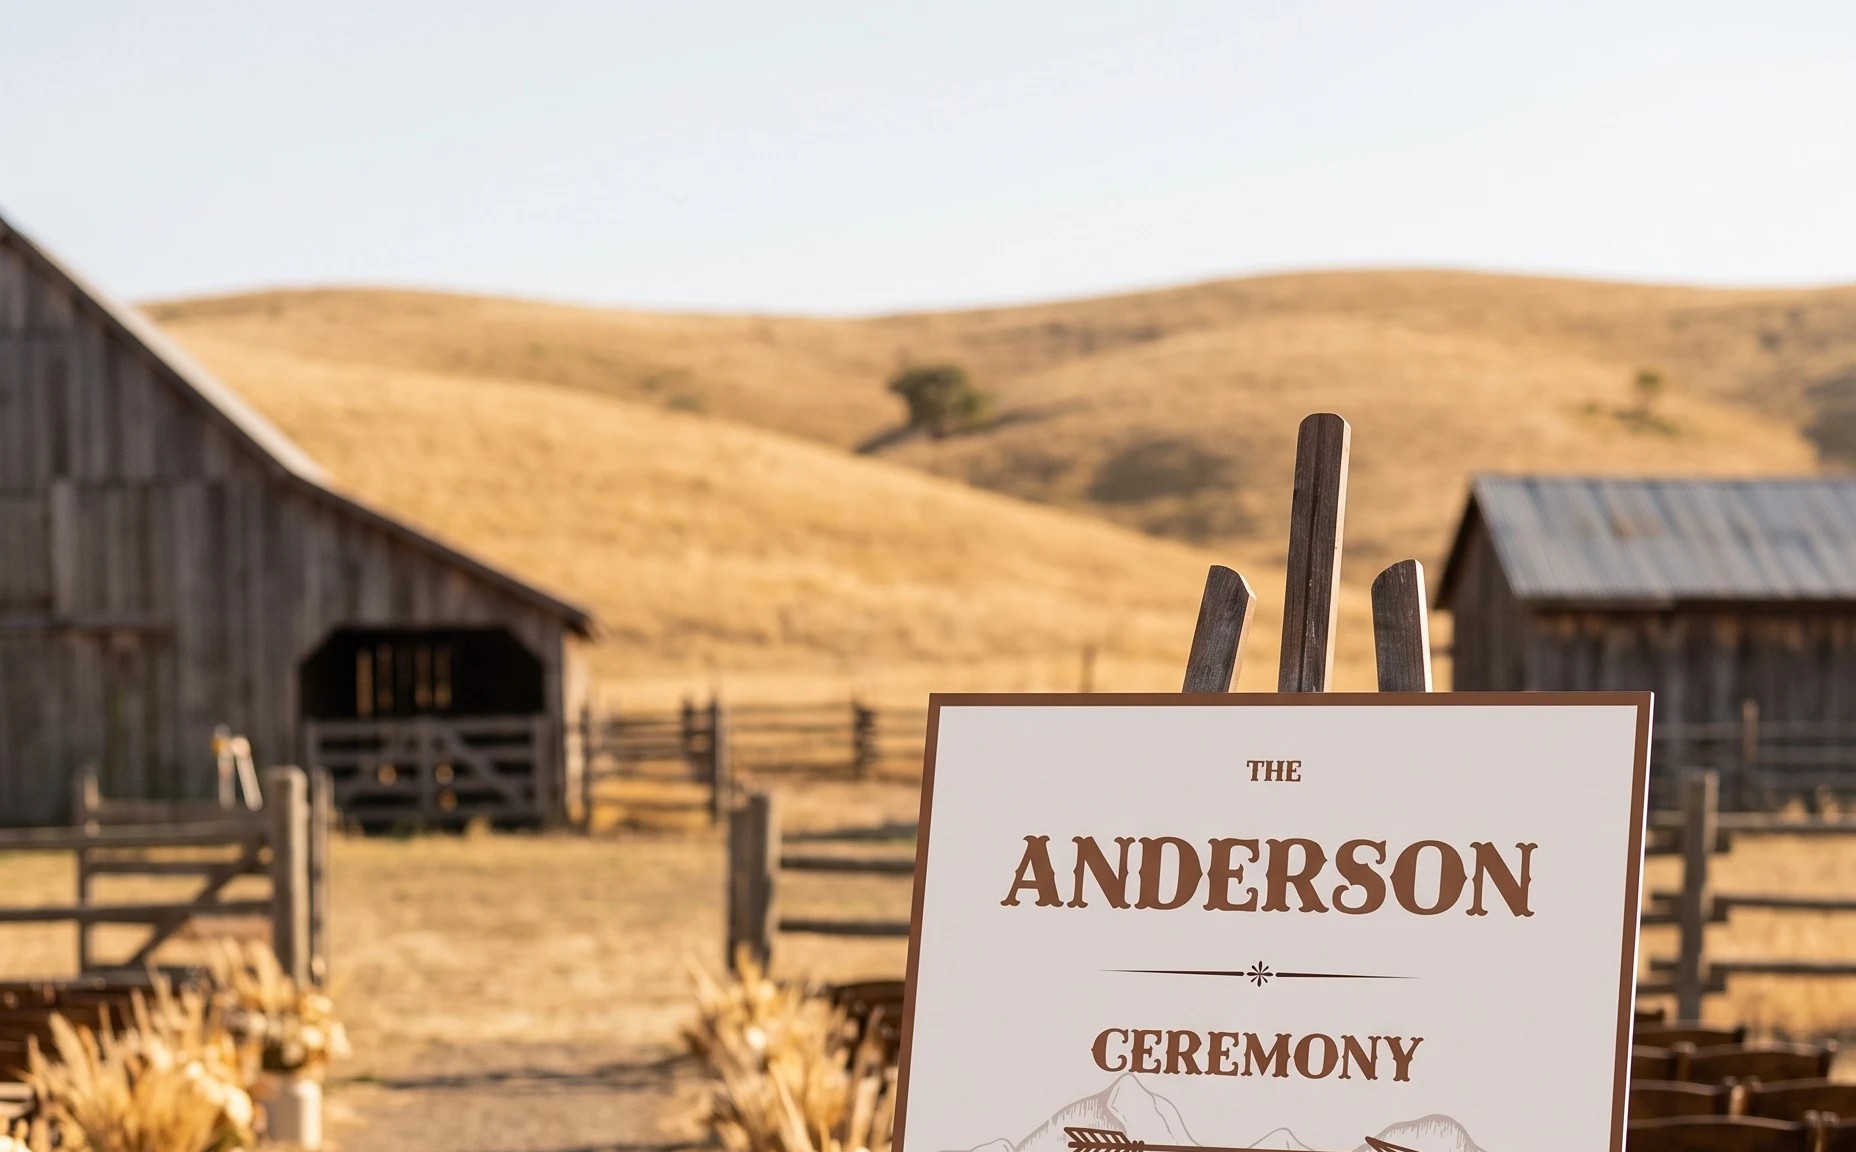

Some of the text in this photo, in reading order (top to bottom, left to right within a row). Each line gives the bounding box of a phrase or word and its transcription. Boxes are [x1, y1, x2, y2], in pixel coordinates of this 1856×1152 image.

[1246, 759, 1302, 783] THE
[1000, 834, 1539, 918] ANDERSON
[1090, 1027, 1425, 1083] CEREMONY
